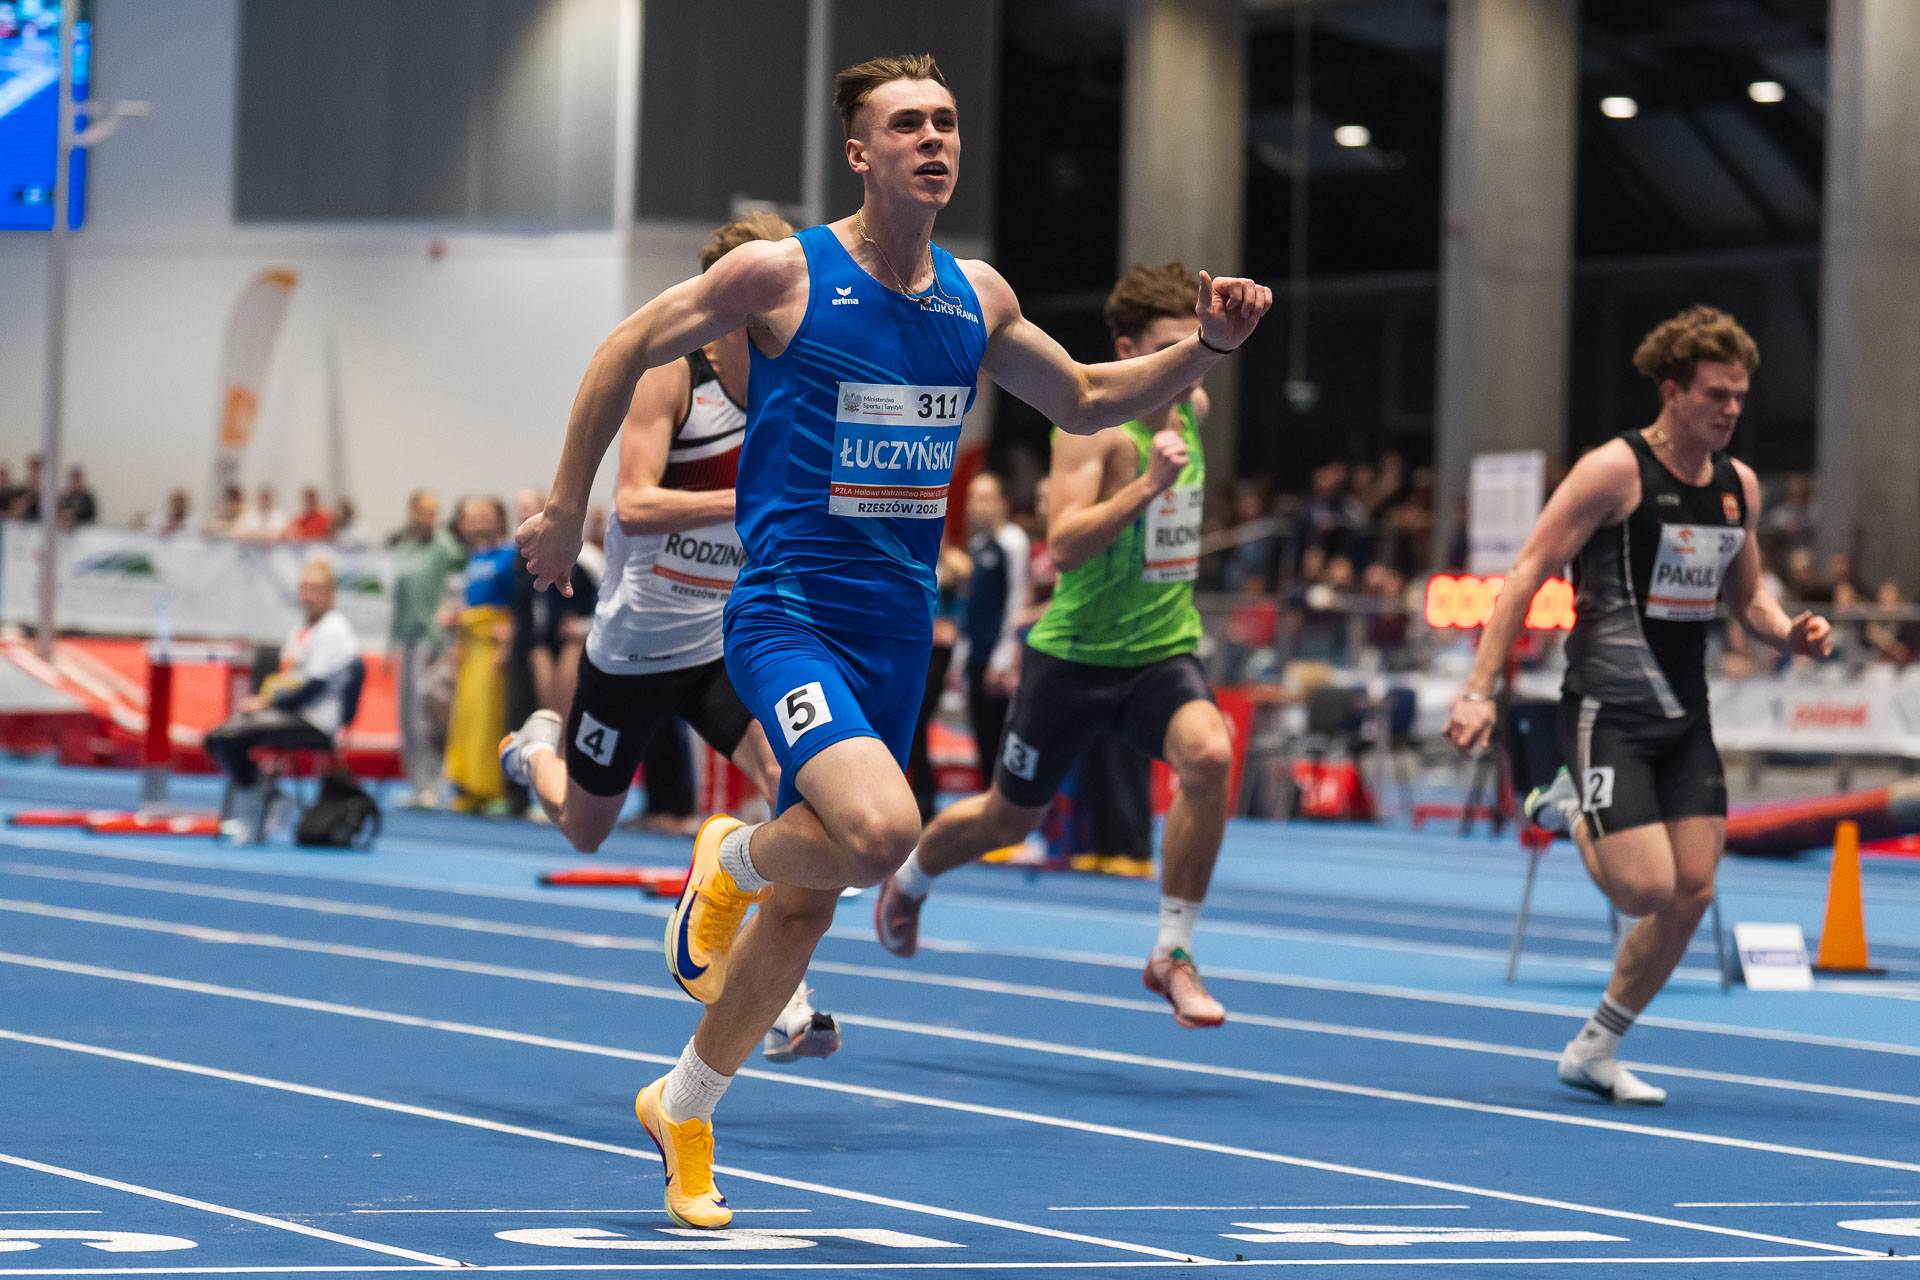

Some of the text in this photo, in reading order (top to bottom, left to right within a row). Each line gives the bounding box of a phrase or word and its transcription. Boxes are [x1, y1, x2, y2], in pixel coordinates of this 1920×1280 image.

[832, 296, 859, 306] erima
[956, 308, 979, 325] RAWA
[862, 402, 881, 410] Sportu
[917, 393, 958, 419] 311
[840, 435, 954, 471] ŁUCZYŃSKI
[834, 487, 853, 495] PZLA
[854, 488, 880, 497] Halowe
[880, 489, 919, 498] Mistrzostwa
[858, 500, 938, 515] RZESZÓW 2026
[785, 687, 816, 732] 5
[582, 727, 605, 759] 4
[1010, 743, 1027, 772] 3
[1590, 771, 1604, 805] 2
[494, 1228, 969, 1251] 5
